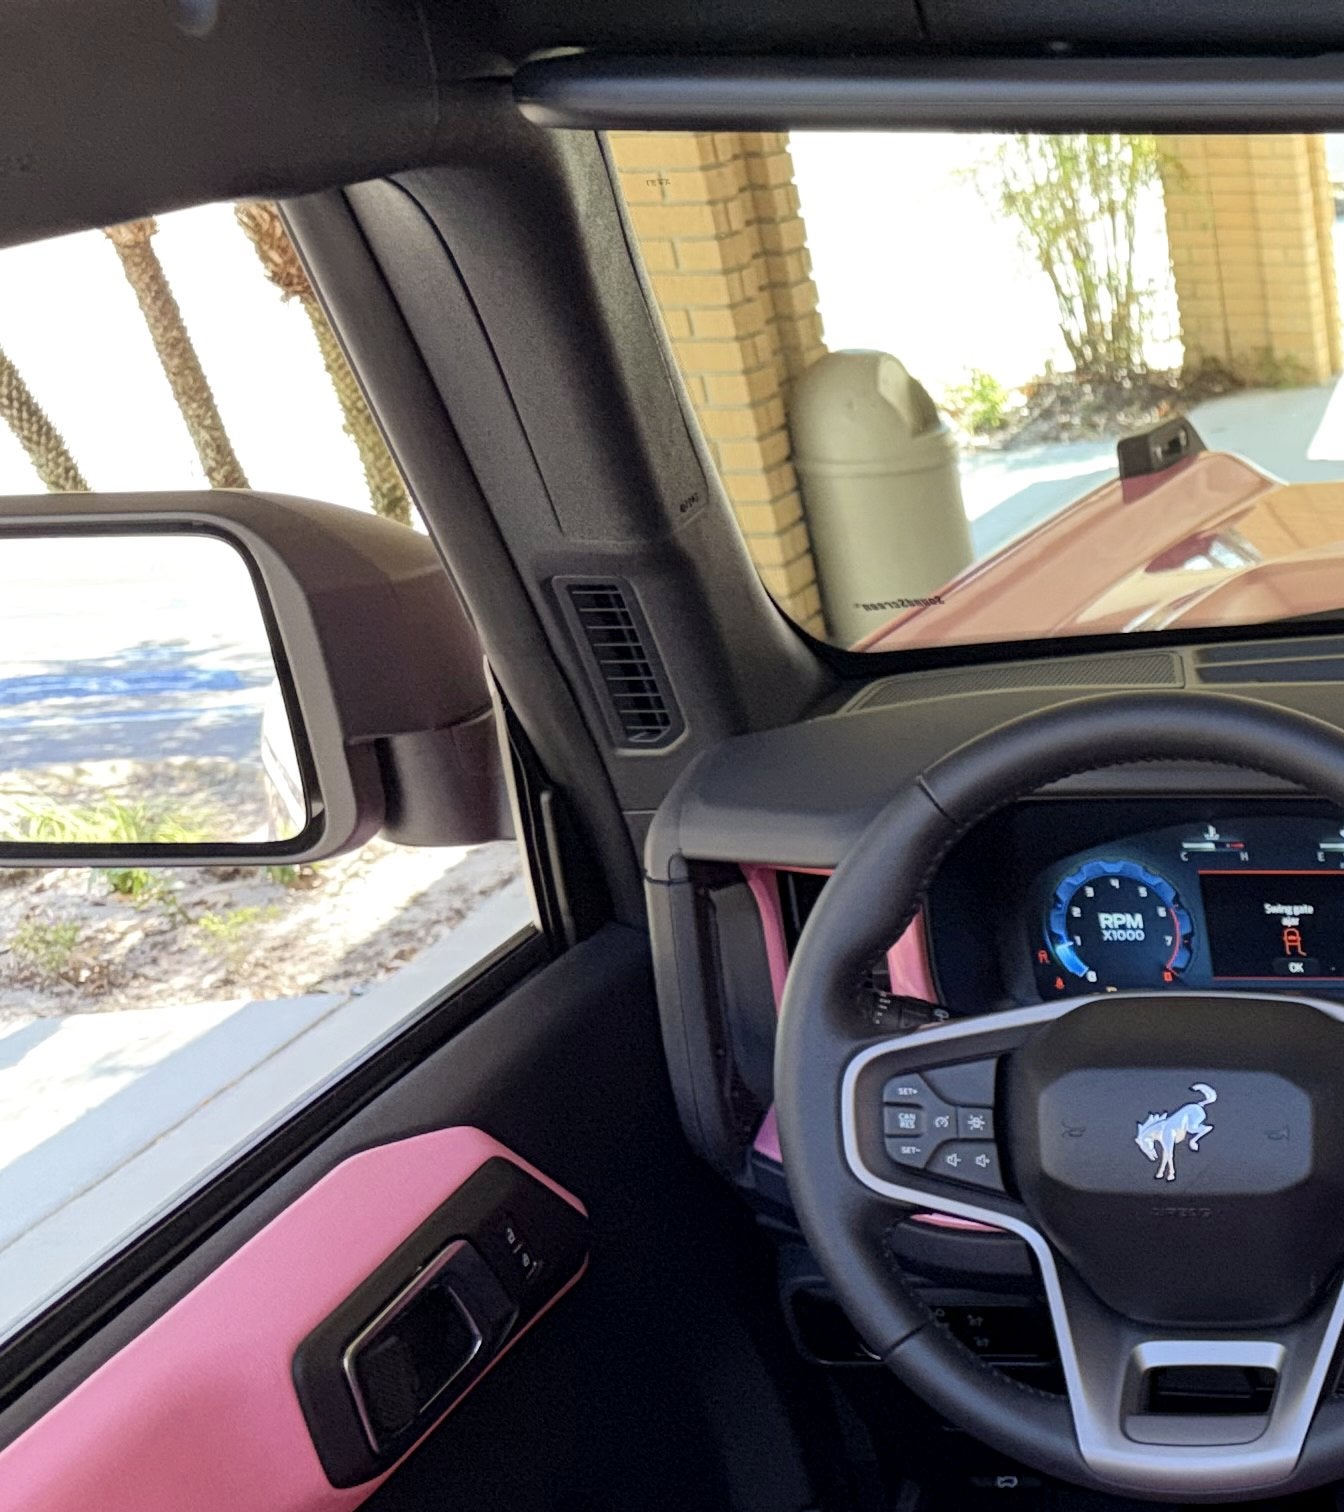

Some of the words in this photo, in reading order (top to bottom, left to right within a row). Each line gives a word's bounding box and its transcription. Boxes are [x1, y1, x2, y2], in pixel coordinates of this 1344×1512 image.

[1180, 851, 1188, 861] C
[1240, 851, 1249, 861] H
[1317, 852, 1325, 862] E
[1110, 878, 1120, 889] 4
[1085, 886, 1094, 898] 3
[1138, 886, 1147, 897] 5
[1071, 906, 1081, 917] 2
[1157, 906, 1166, 917] 6
[1264, 903, 1293, 916] Swing
[1294, 904, 1314, 916] gate
[1098, 912, 1144, 929] RPM
[1074, 935, 1081, 946] 1
[1164, 935, 1173, 946] 7
[1288, 962, 1304, 974] OK
[1086, 970, 1097, 983] 0
[898, 1112, 916, 1120] CAN
